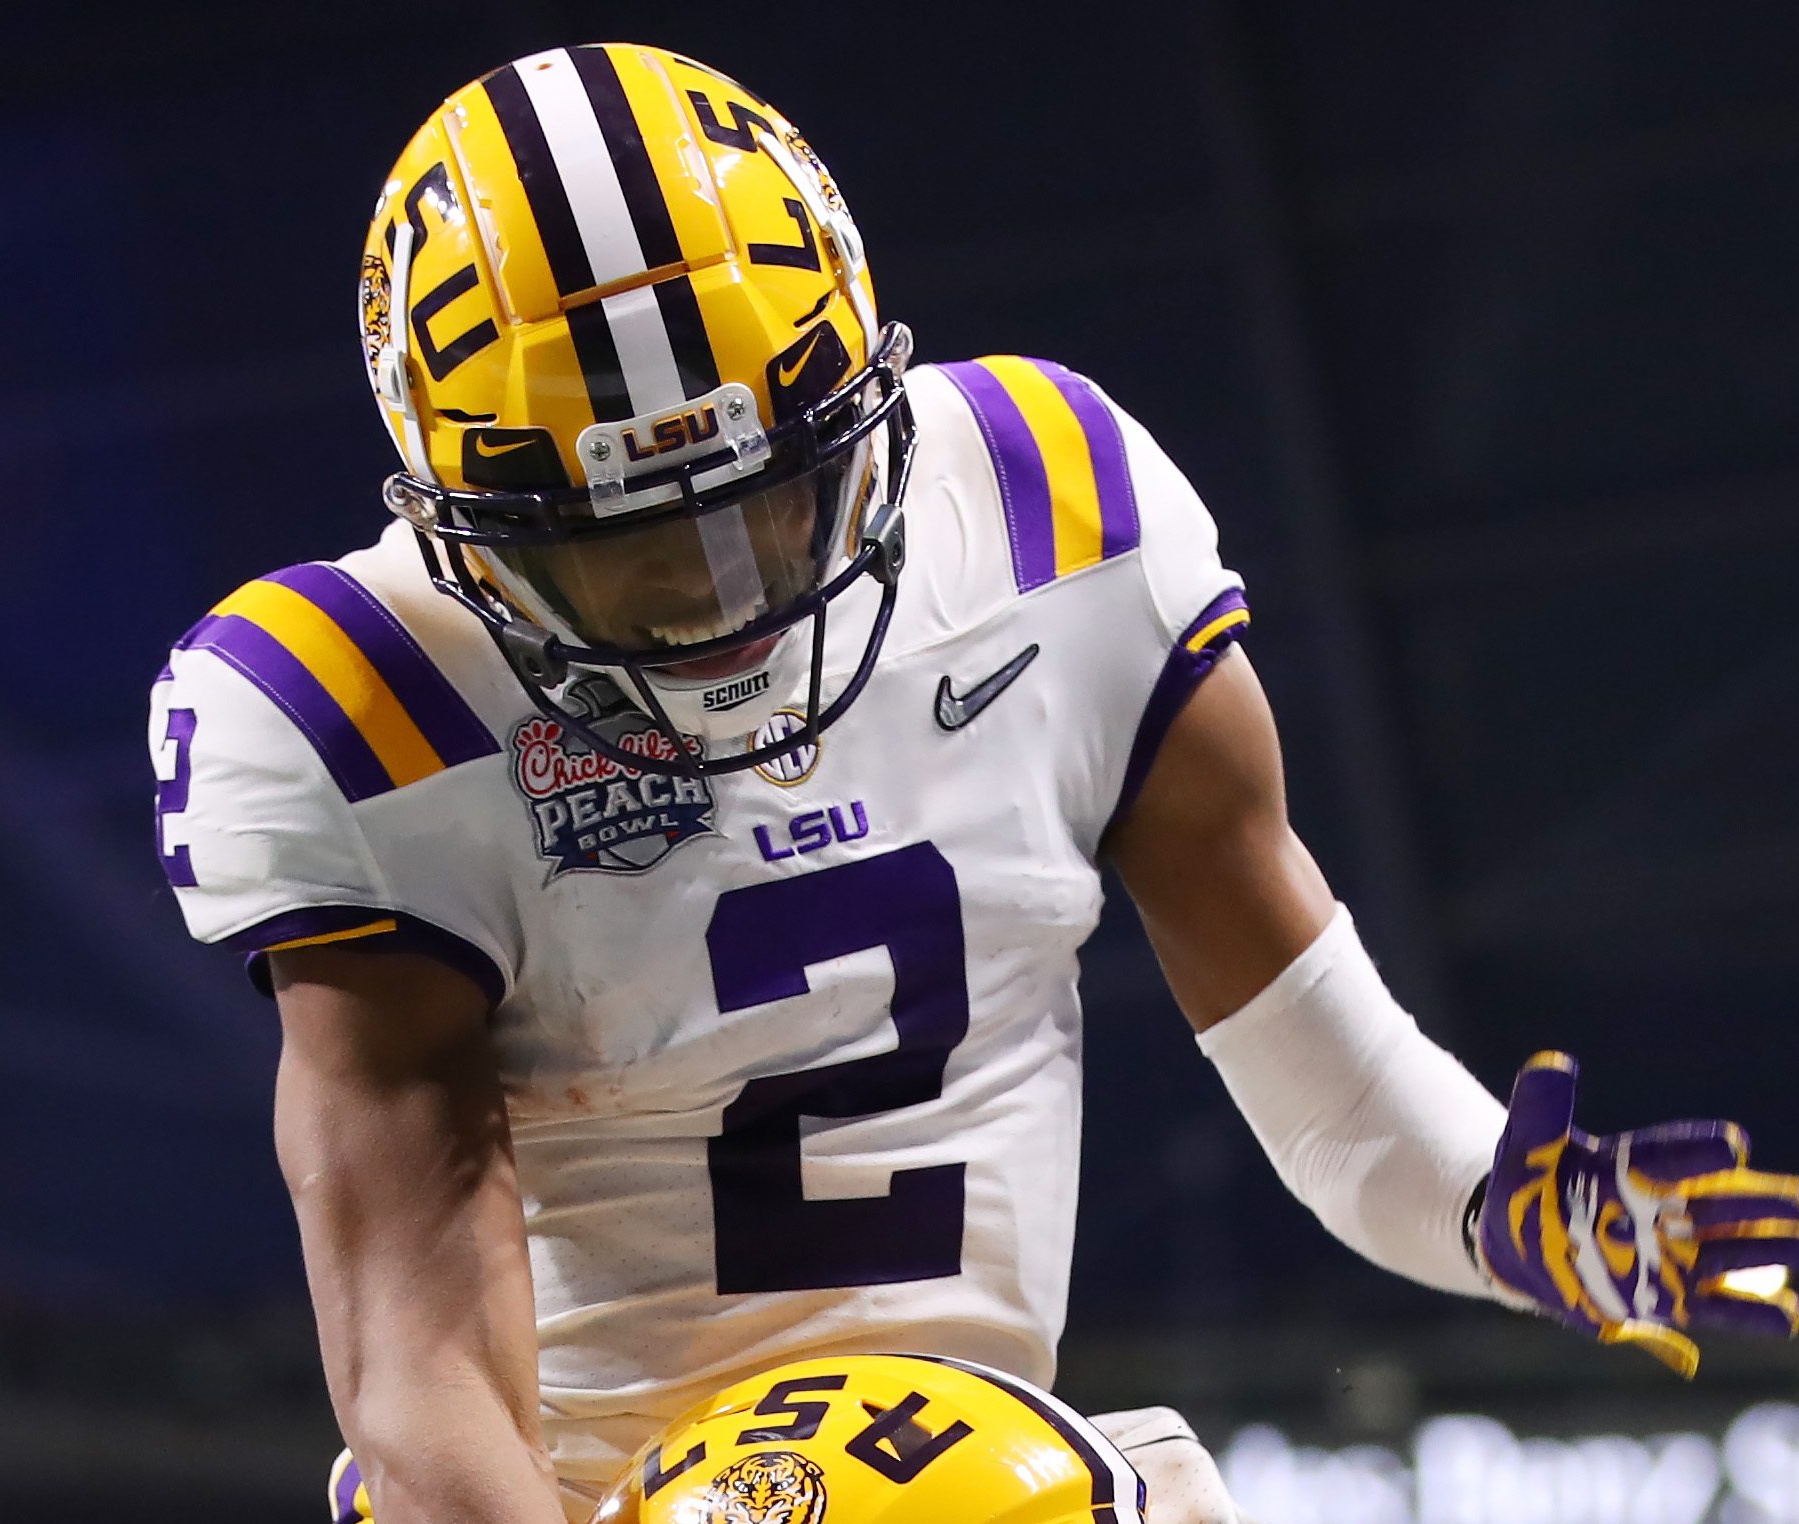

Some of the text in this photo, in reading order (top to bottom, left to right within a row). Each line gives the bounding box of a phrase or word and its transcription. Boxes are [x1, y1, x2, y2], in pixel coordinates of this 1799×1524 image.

[673, 57, 822, 274] LS
[621, 402, 719, 462] LSU
[534, 774, 711, 849] PEACH
[578, 812, 679, 851] BOWL
[753, 799, 871, 864] LSU
[705, 840, 970, 1296] 2
[644, 1373, 975, 1501] LSU
